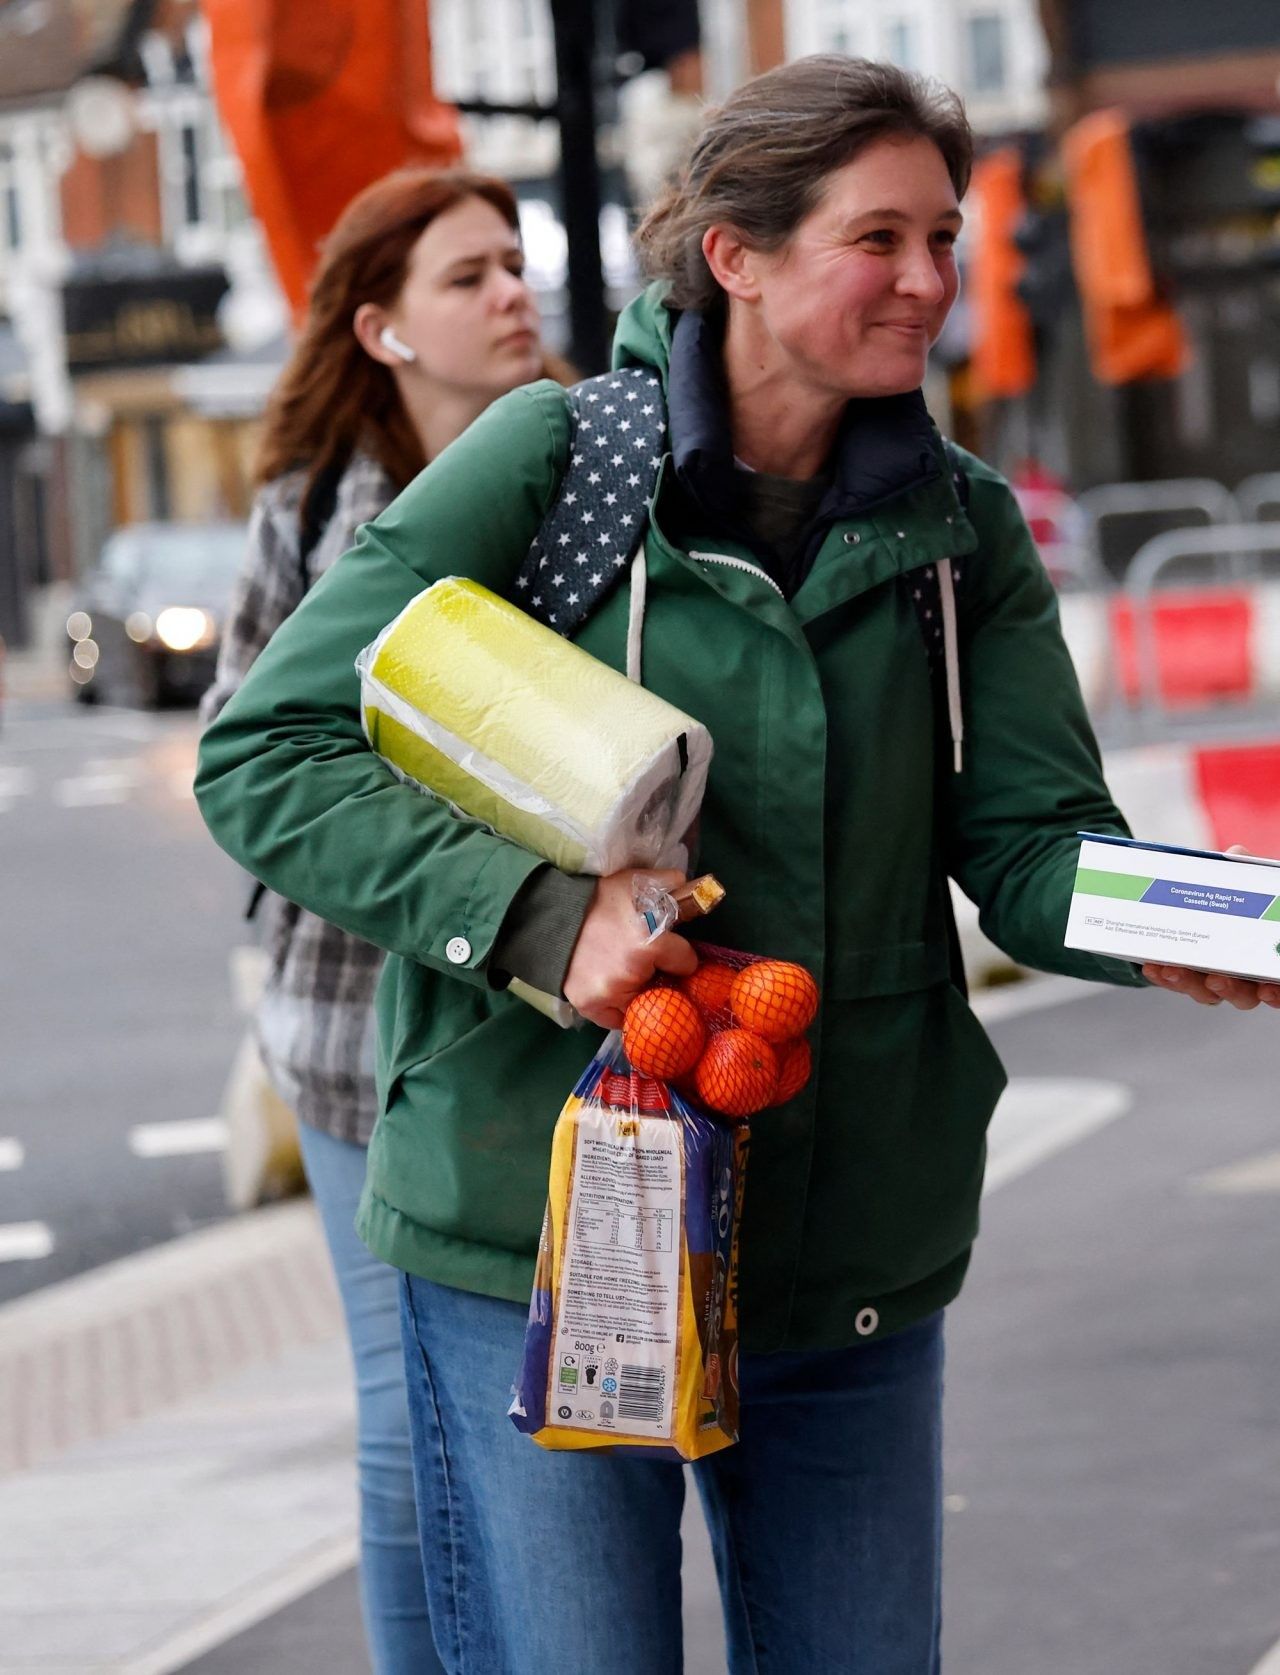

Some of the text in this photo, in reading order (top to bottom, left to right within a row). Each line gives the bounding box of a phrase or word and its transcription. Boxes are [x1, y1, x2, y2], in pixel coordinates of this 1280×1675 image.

[1170, 887, 1205, 898] Coronavirus
[1205, 892, 1214, 900] Ag
[1214, 893, 1232, 902] Rapid
[1183, 897, 1229, 910] Cassette (Swab)
[580, 1192, 605, 1200] NUTRITION
[569, 1271, 592, 1279] SUITABLE
[567, 1289, 595, 1297] SOMETHING
[574, 1340, 595, 1354] 800g
